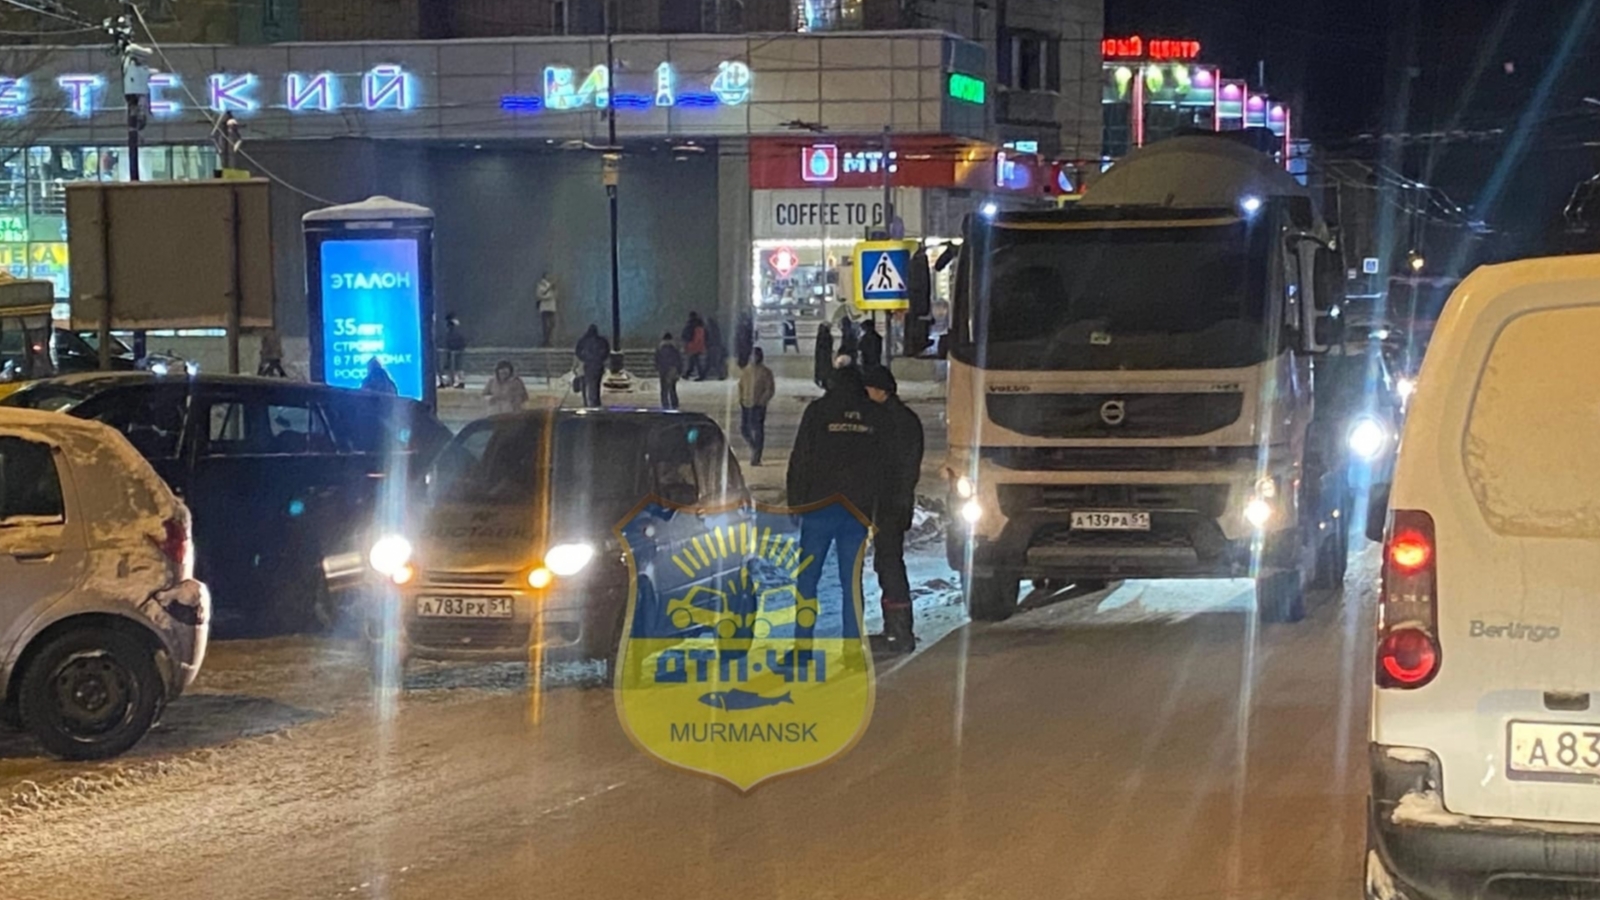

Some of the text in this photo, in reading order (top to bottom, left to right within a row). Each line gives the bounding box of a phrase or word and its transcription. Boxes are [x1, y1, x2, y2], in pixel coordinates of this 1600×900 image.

[1149, 40, 1200, 59] ЦЕНТР
[842, 151, 898, 173] МТС
[776, 203, 894, 225] COFFEE TO G
[330, 272, 411, 289] ЭТАЛОН
[333, 318, 357, 336] 35
[344, 355, 351, 366] 7
[989, 385, 1031, 393] VOLVO
[828, 423, 873, 434] ДОСТАВ
[1076, 513, 1146, 527] А139РА 51
[423, 598, 507, 615] А783РХ 51
[1469, 620, 1561, 642] Berlingo
[1528, 731, 1600, 767] А83
